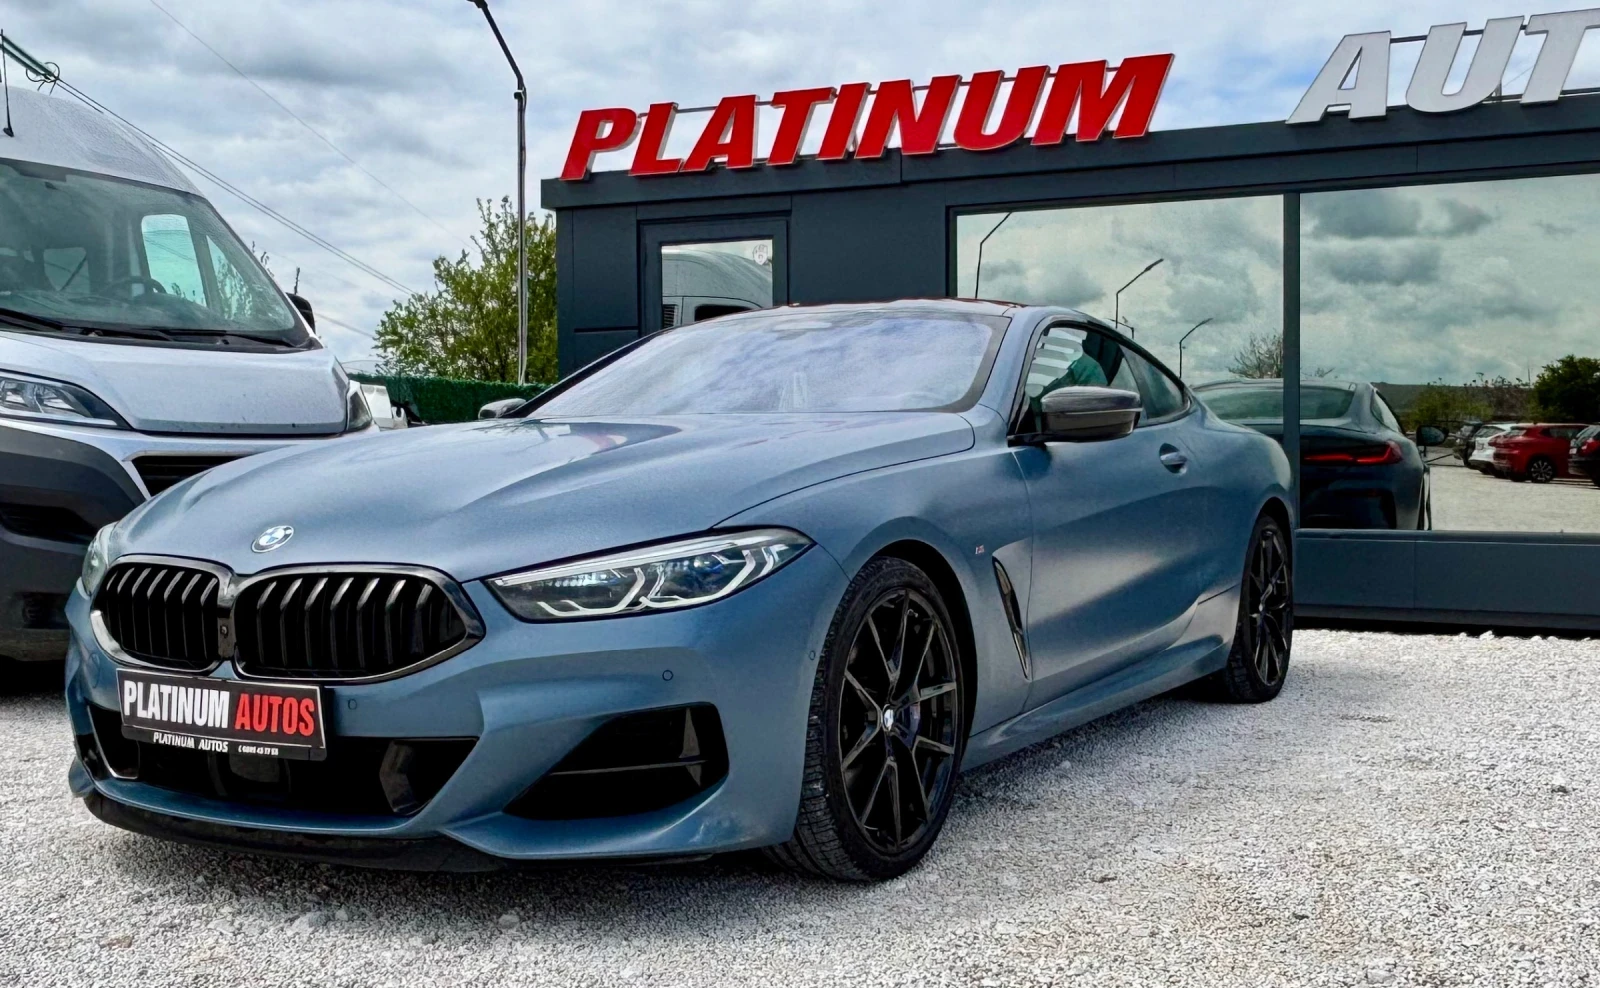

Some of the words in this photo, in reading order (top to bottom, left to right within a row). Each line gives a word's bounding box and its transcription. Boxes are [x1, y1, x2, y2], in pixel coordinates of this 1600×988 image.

[560, 53, 1174, 181] PLATINUM
[124, 680, 230, 728] PLATINUM
[235, 693, 315, 736] AUTOS
[153, 732, 195, 748] PLATINUM
[198, 739, 228, 753] AUTOS
